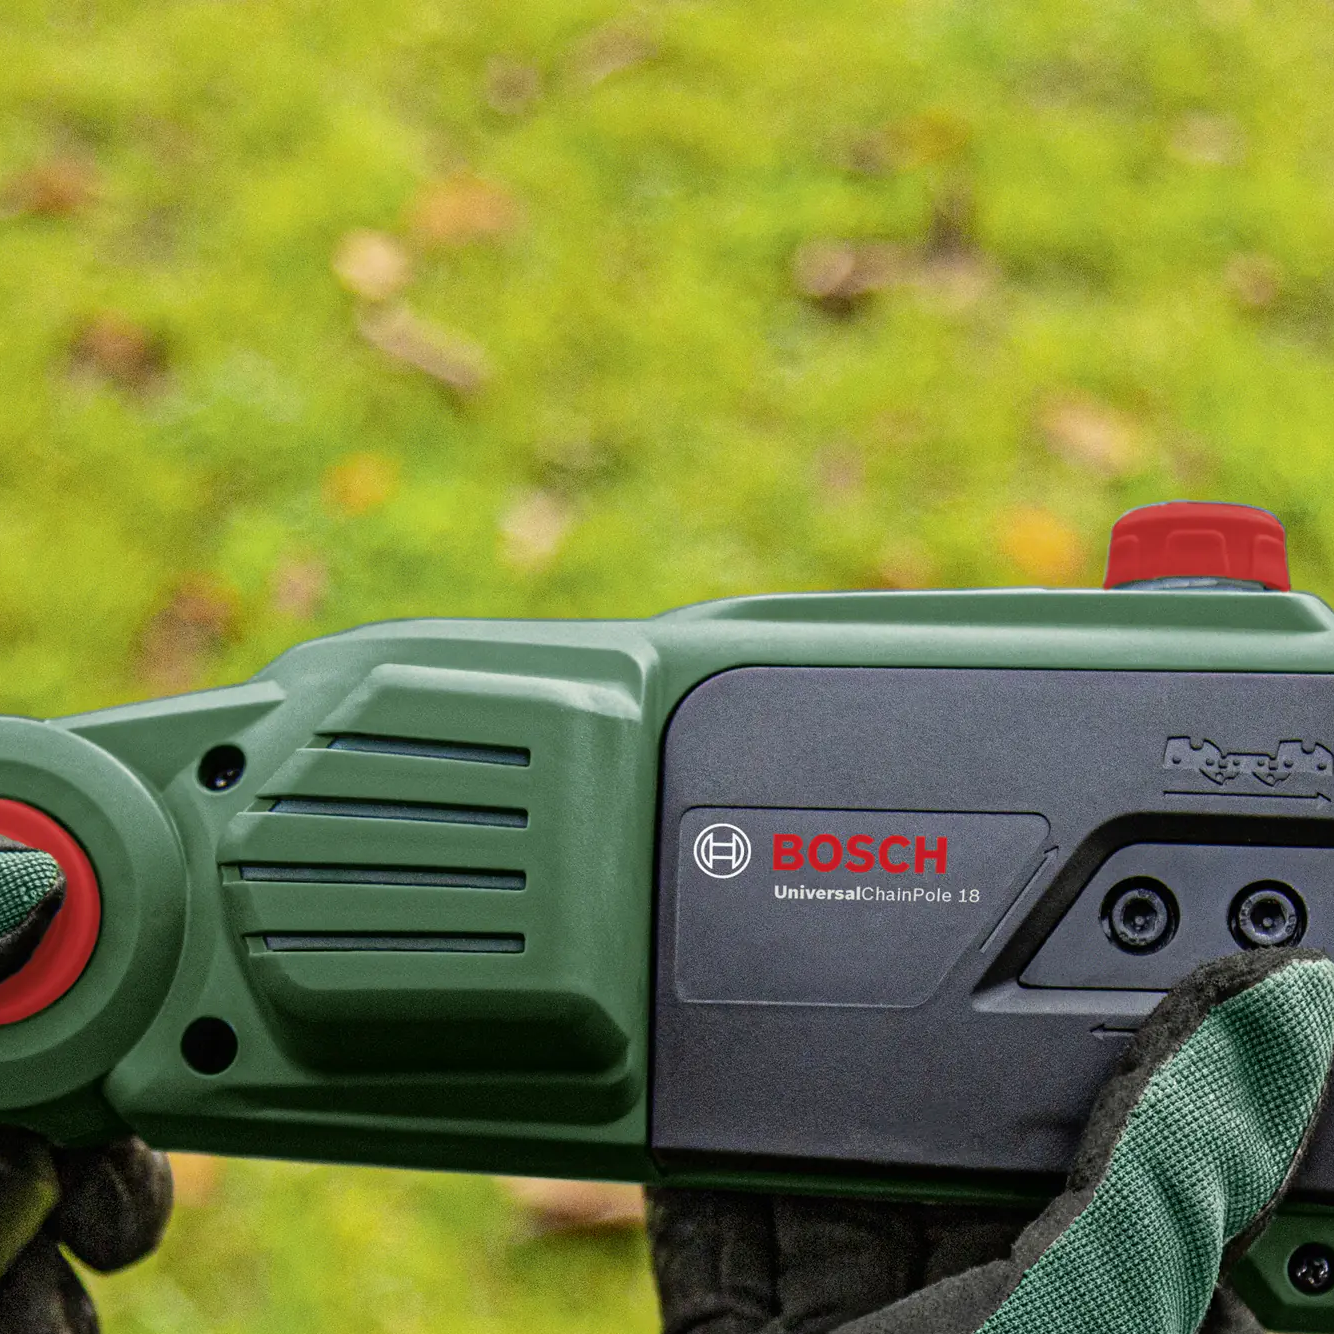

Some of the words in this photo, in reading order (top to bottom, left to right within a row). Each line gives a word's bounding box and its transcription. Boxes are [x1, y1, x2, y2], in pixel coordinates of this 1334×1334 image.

[772, 833, 948, 874] BOSCH
[774, 885, 952, 902] UniversalChainPole
[958, 888, 980, 903] 18
